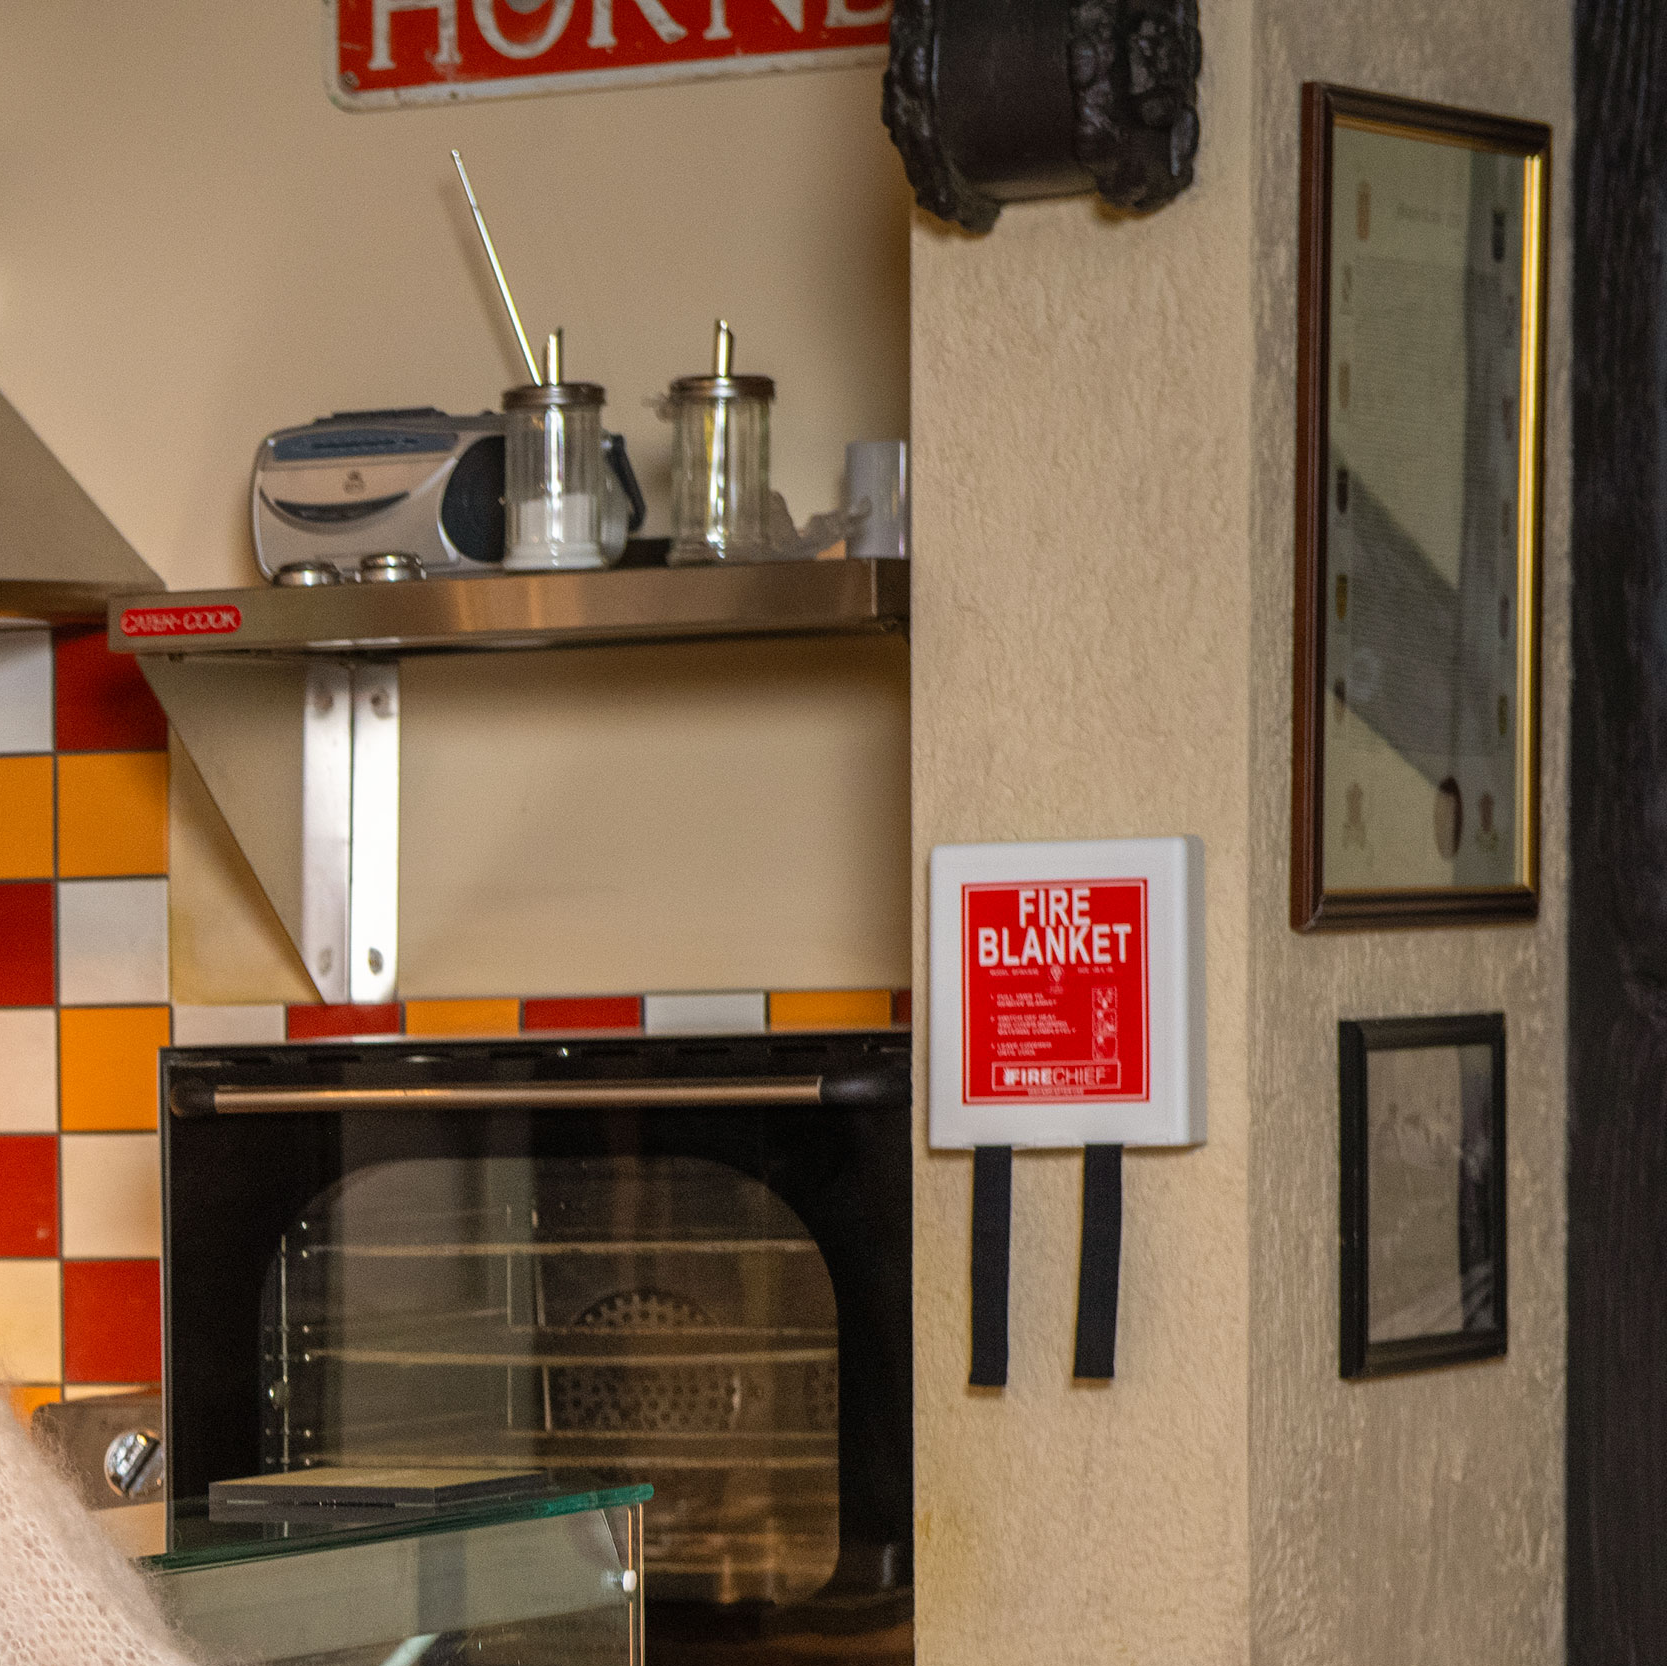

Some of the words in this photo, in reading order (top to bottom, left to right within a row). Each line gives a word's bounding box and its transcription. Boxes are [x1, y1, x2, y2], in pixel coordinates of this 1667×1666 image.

[1018, 887, 1091, 928] FIRE
[978, 923, 1132, 967] BLANKET
[1004, 1066, 1106, 1087] FIRECHIEF
